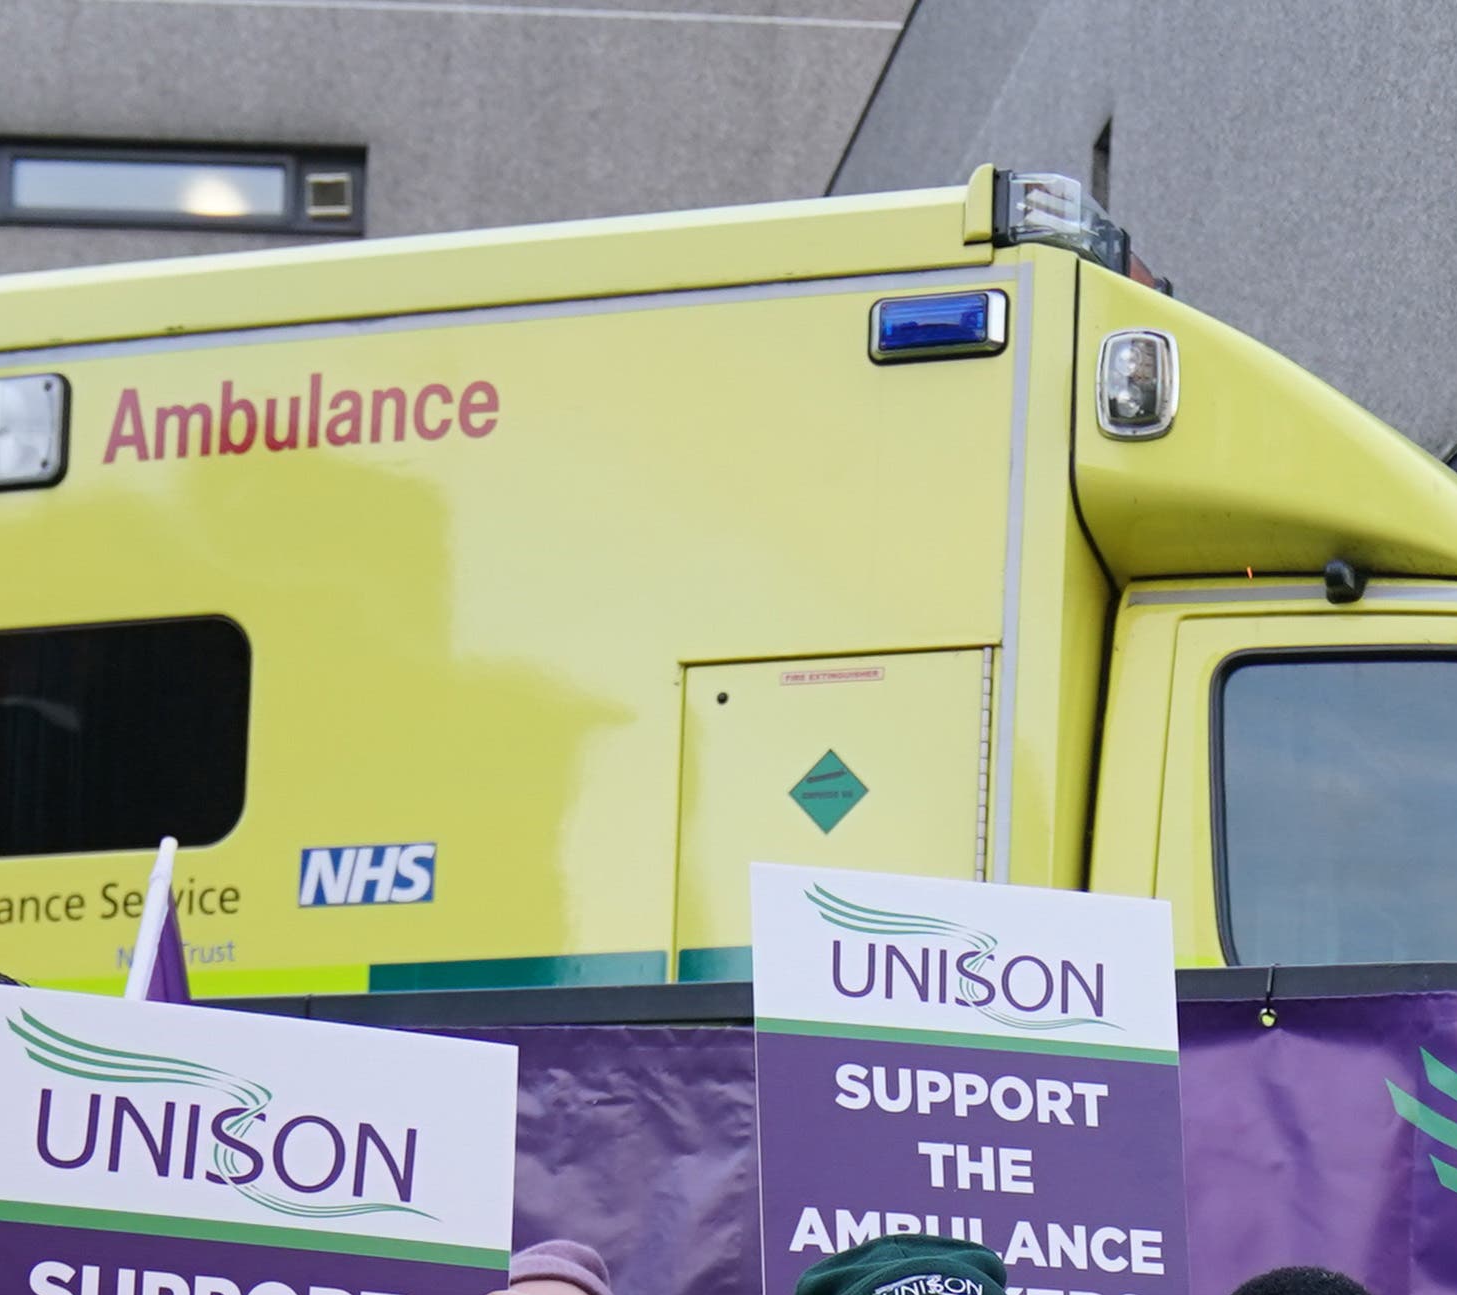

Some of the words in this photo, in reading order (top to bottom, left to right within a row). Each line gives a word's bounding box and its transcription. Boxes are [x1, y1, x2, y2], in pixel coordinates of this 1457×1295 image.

[103, 373, 500, 464] Ambulance
[303, 846, 433, 904] NHS
[831, 939, 1104, 1018] UNISON
[834, 1063, 1108, 1128] SUPPORT
[35, 1089, 418, 1203] UNISON
[918, 1142, 1035, 1195] THE
